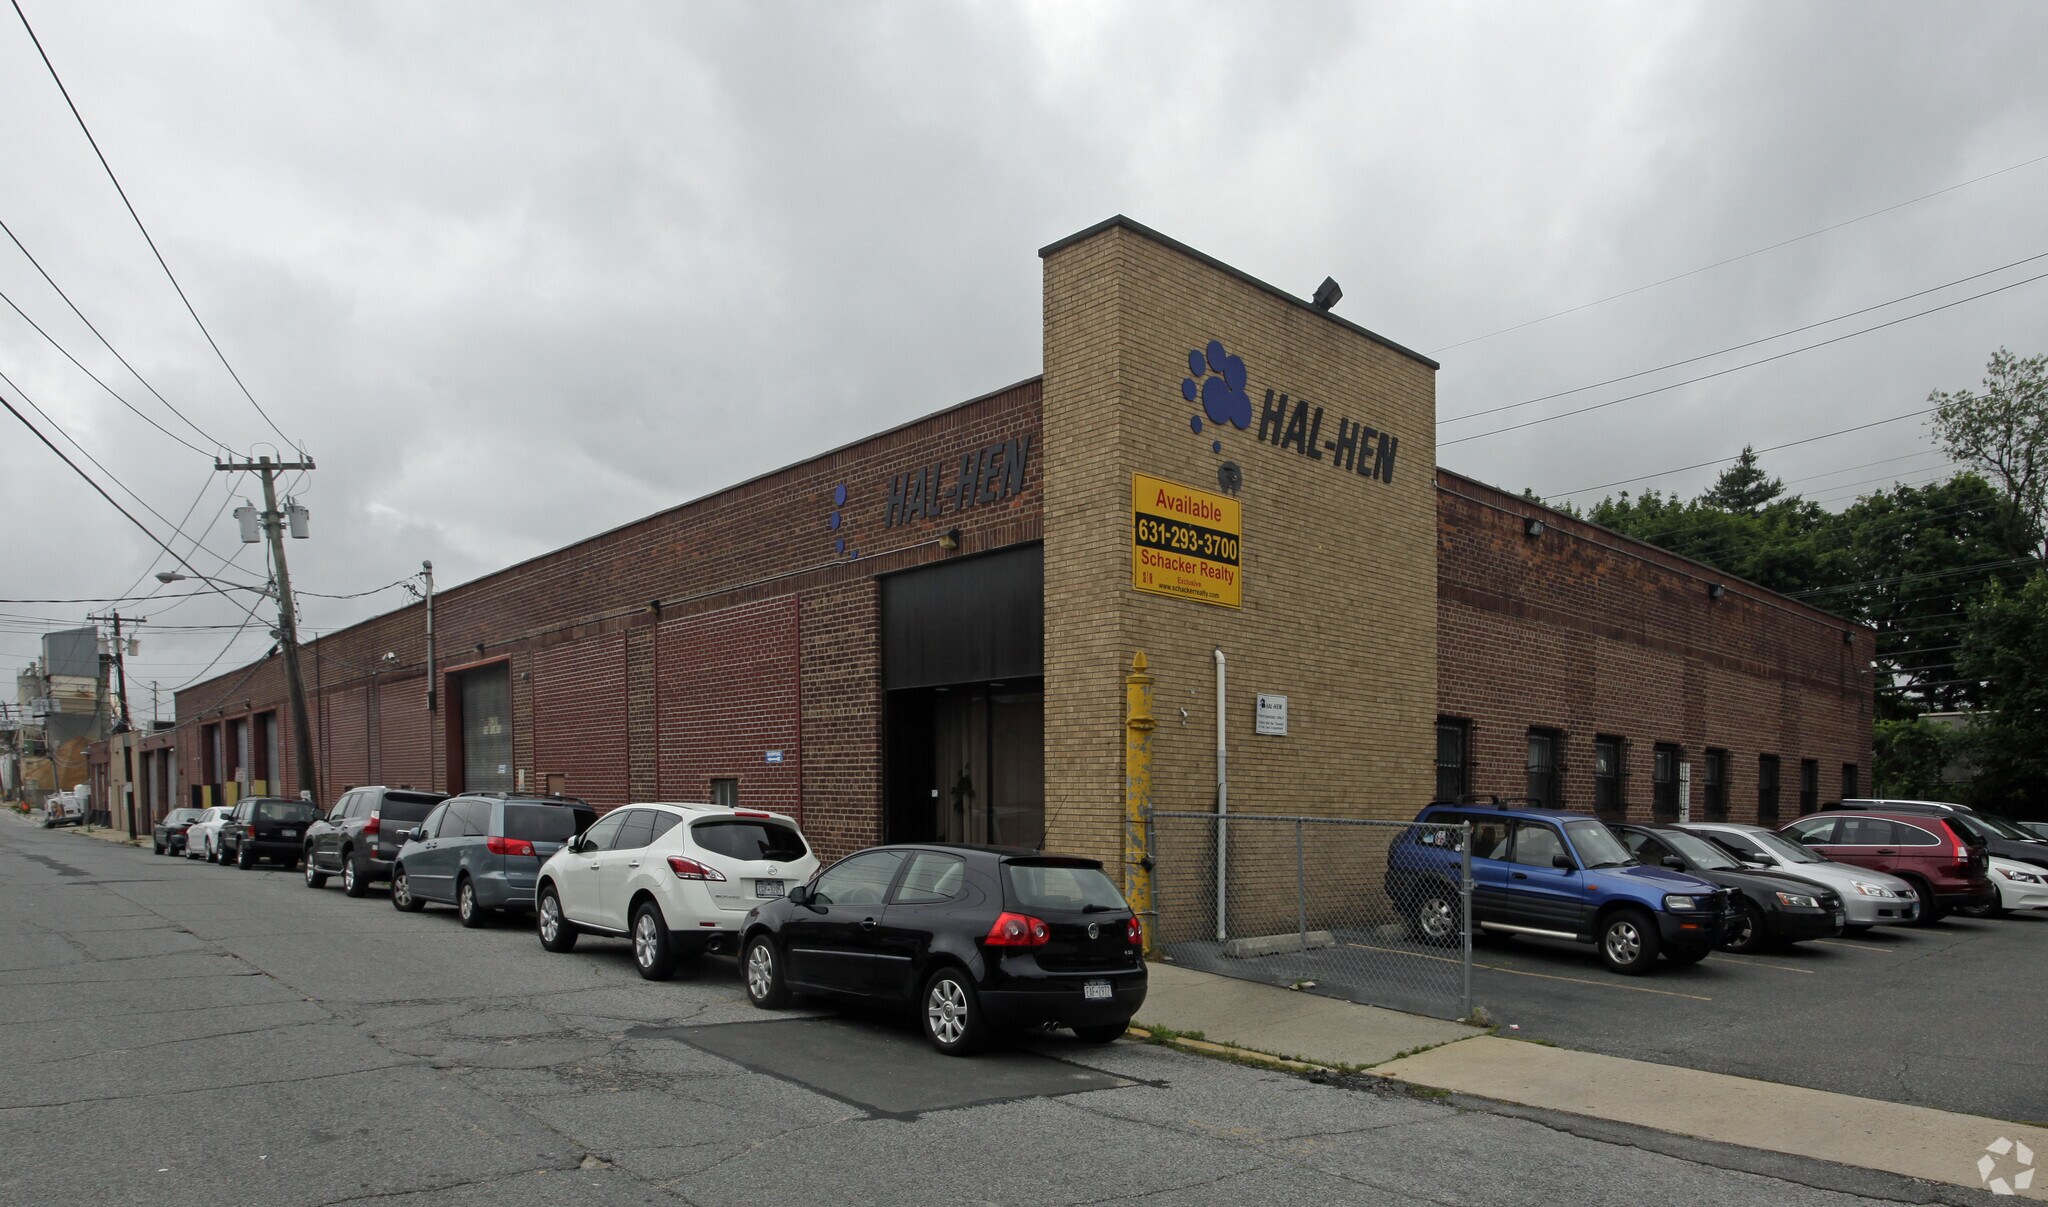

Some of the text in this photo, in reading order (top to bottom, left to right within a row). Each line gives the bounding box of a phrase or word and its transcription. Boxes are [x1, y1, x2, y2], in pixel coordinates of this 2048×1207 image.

[1258, 388, 1399, 484] HAL-HEN
[885, 434, 1031, 528] HAL-HEN
[1156, 488, 1222, 522] Available
[1138, 518, 1237, 561] 631-293-3700
[1141, 548, 1235, 586] Schacker Realty
[1177, 576, 1202, 588] Exclusive
[1158, 582, 1220, 599] www.schackerrealty.com
